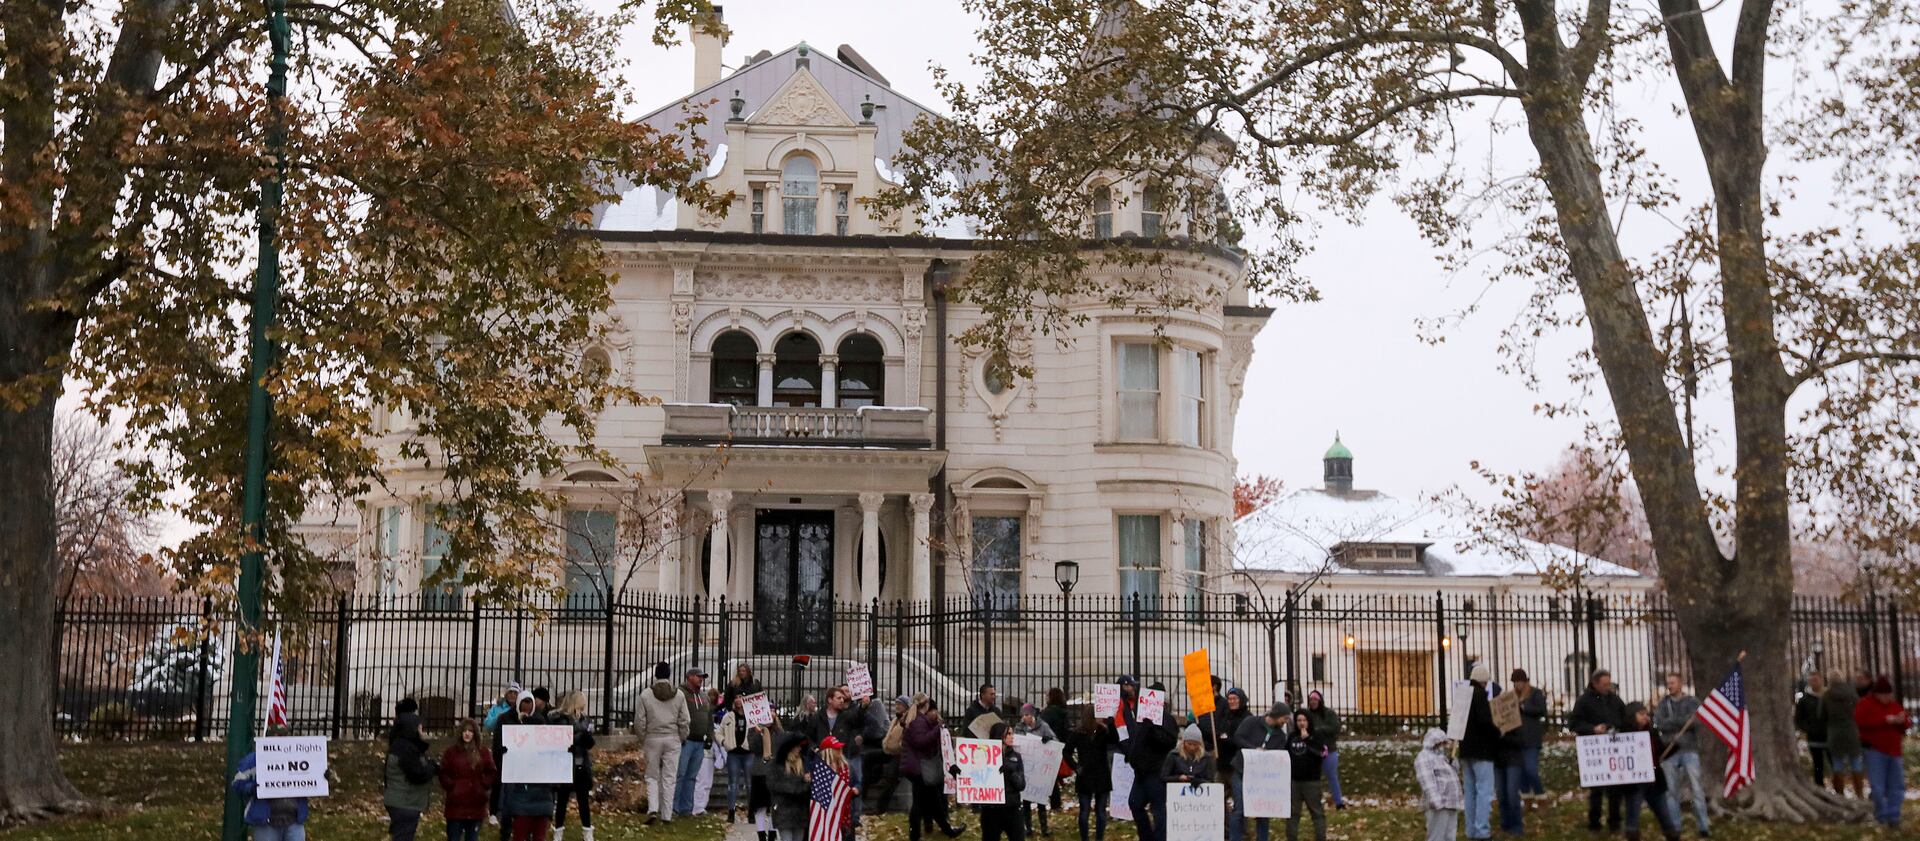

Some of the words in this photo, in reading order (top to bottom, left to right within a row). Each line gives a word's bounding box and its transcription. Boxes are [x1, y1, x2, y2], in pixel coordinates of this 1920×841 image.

[284, 745, 292, 753] of
[296, 743, 322, 753] Rights
[288, 760, 309, 771] NO
[1609, 756, 1634, 771] GOD
[958, 777, 971, 786] THE
[959, 787, 1004, 801] TYRANNY
[1173, 801, 1216, 812] Dictator
[1172, 818, 1218, 832] Herbert
